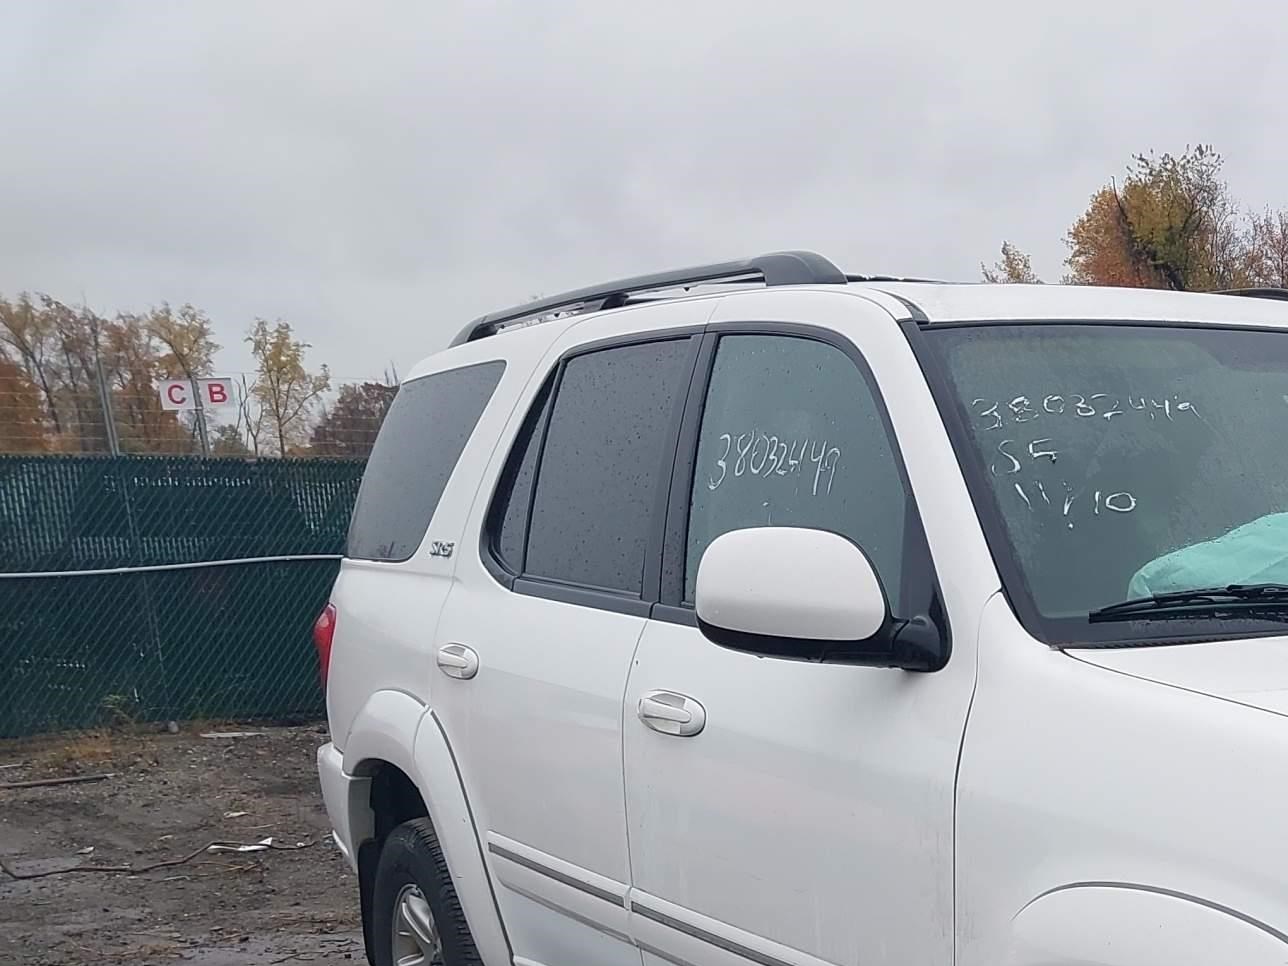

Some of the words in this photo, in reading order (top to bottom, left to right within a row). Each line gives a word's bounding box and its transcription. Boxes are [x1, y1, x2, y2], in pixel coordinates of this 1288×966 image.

[167, 384, 187, 405] C
[207, 383, 228, 403] B
[708, 430, 841, 496] 38032449
